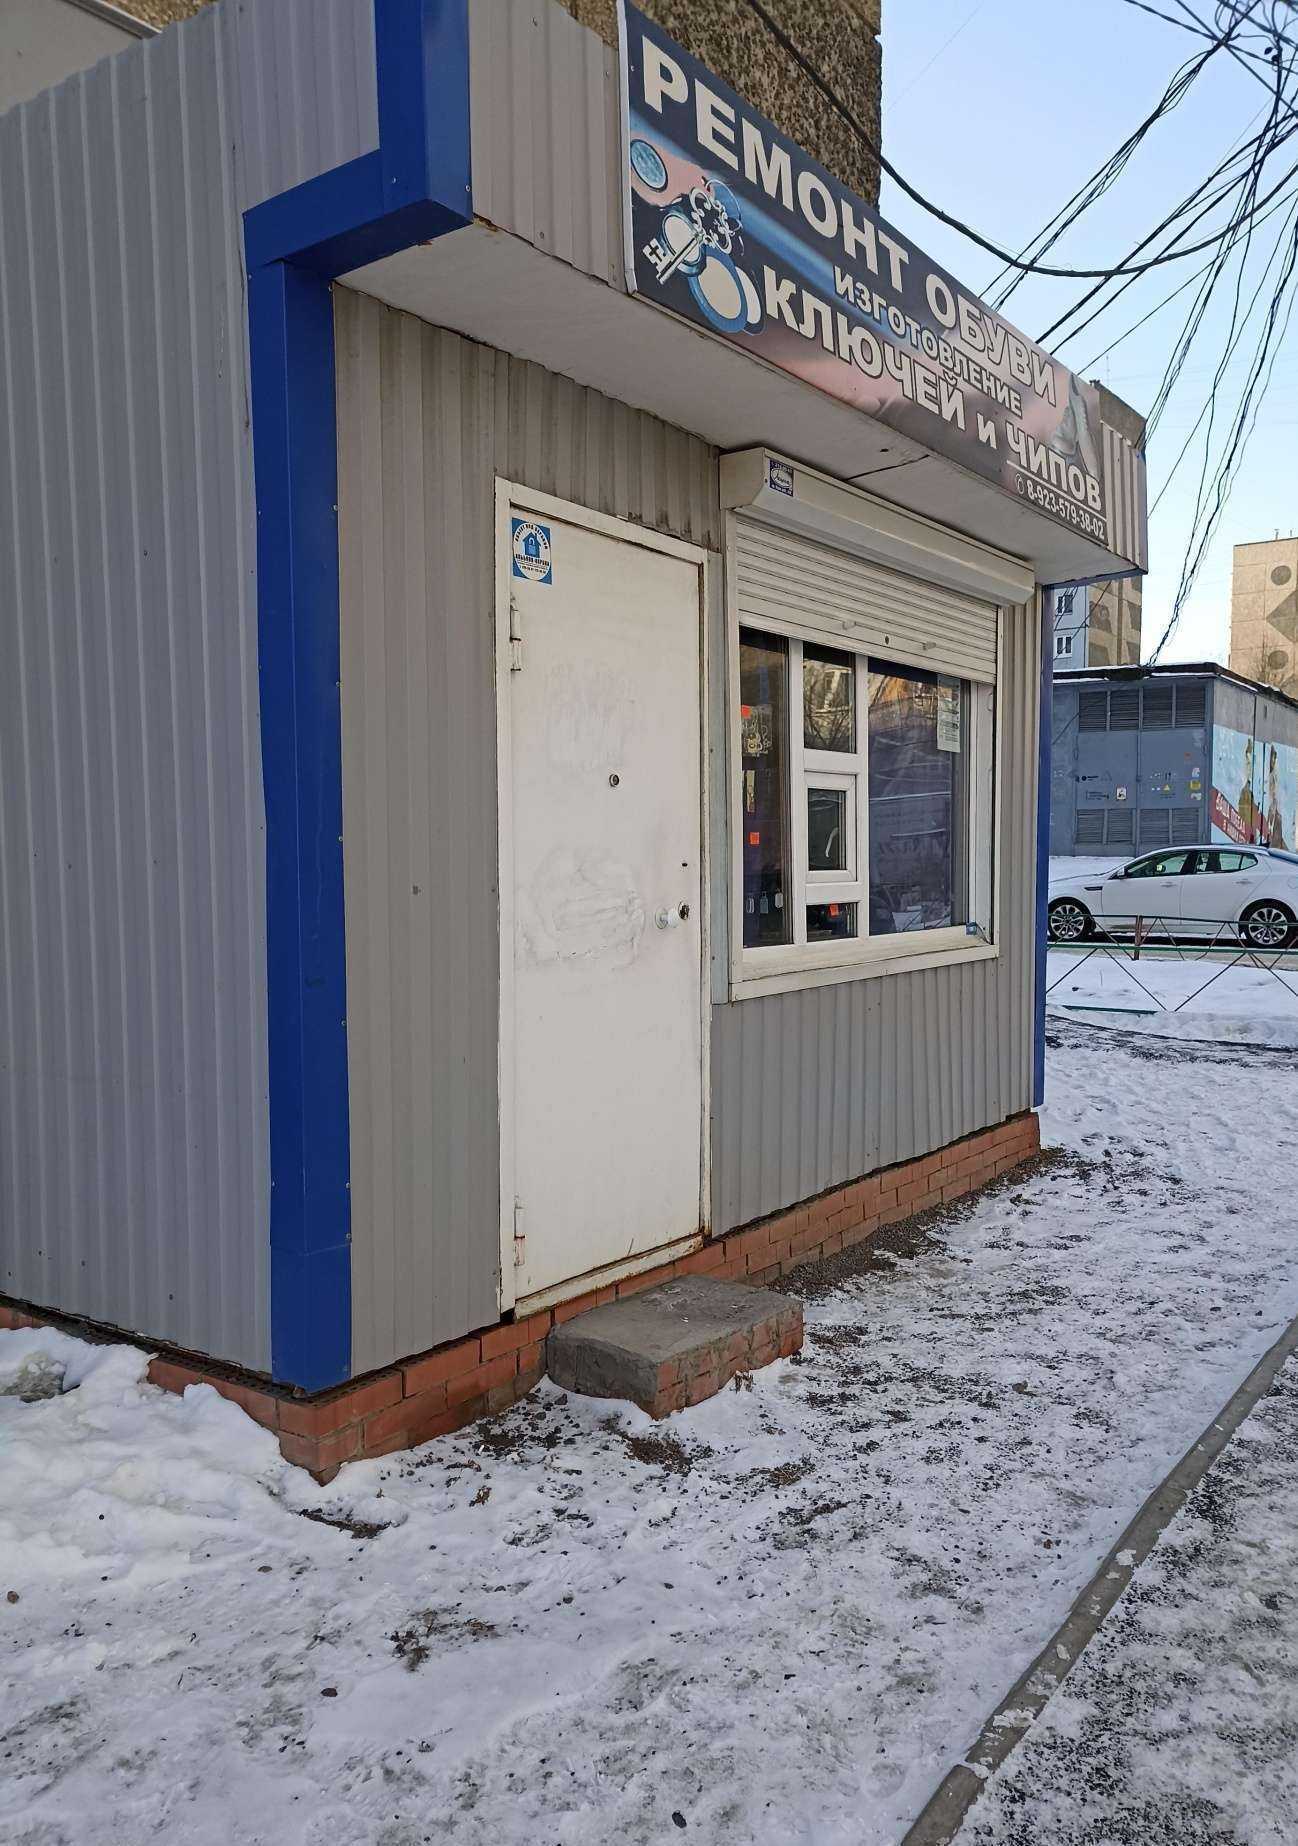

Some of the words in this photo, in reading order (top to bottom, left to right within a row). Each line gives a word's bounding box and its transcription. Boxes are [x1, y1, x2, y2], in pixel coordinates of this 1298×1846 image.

[642, 35, 909, 293] РЕМОНТ
[925, 273, 1057, 407] ОБУВИ
[763, 265, 966, 431] КЛЮЧЕЙ
[1005, 421, 1102, 511] ЧИПОВ
[834, 265, 1024, 418] ИЗГОТОВЛЕНИЕ
[1026, 480, 1105, 540] 8-923-579-38-02
